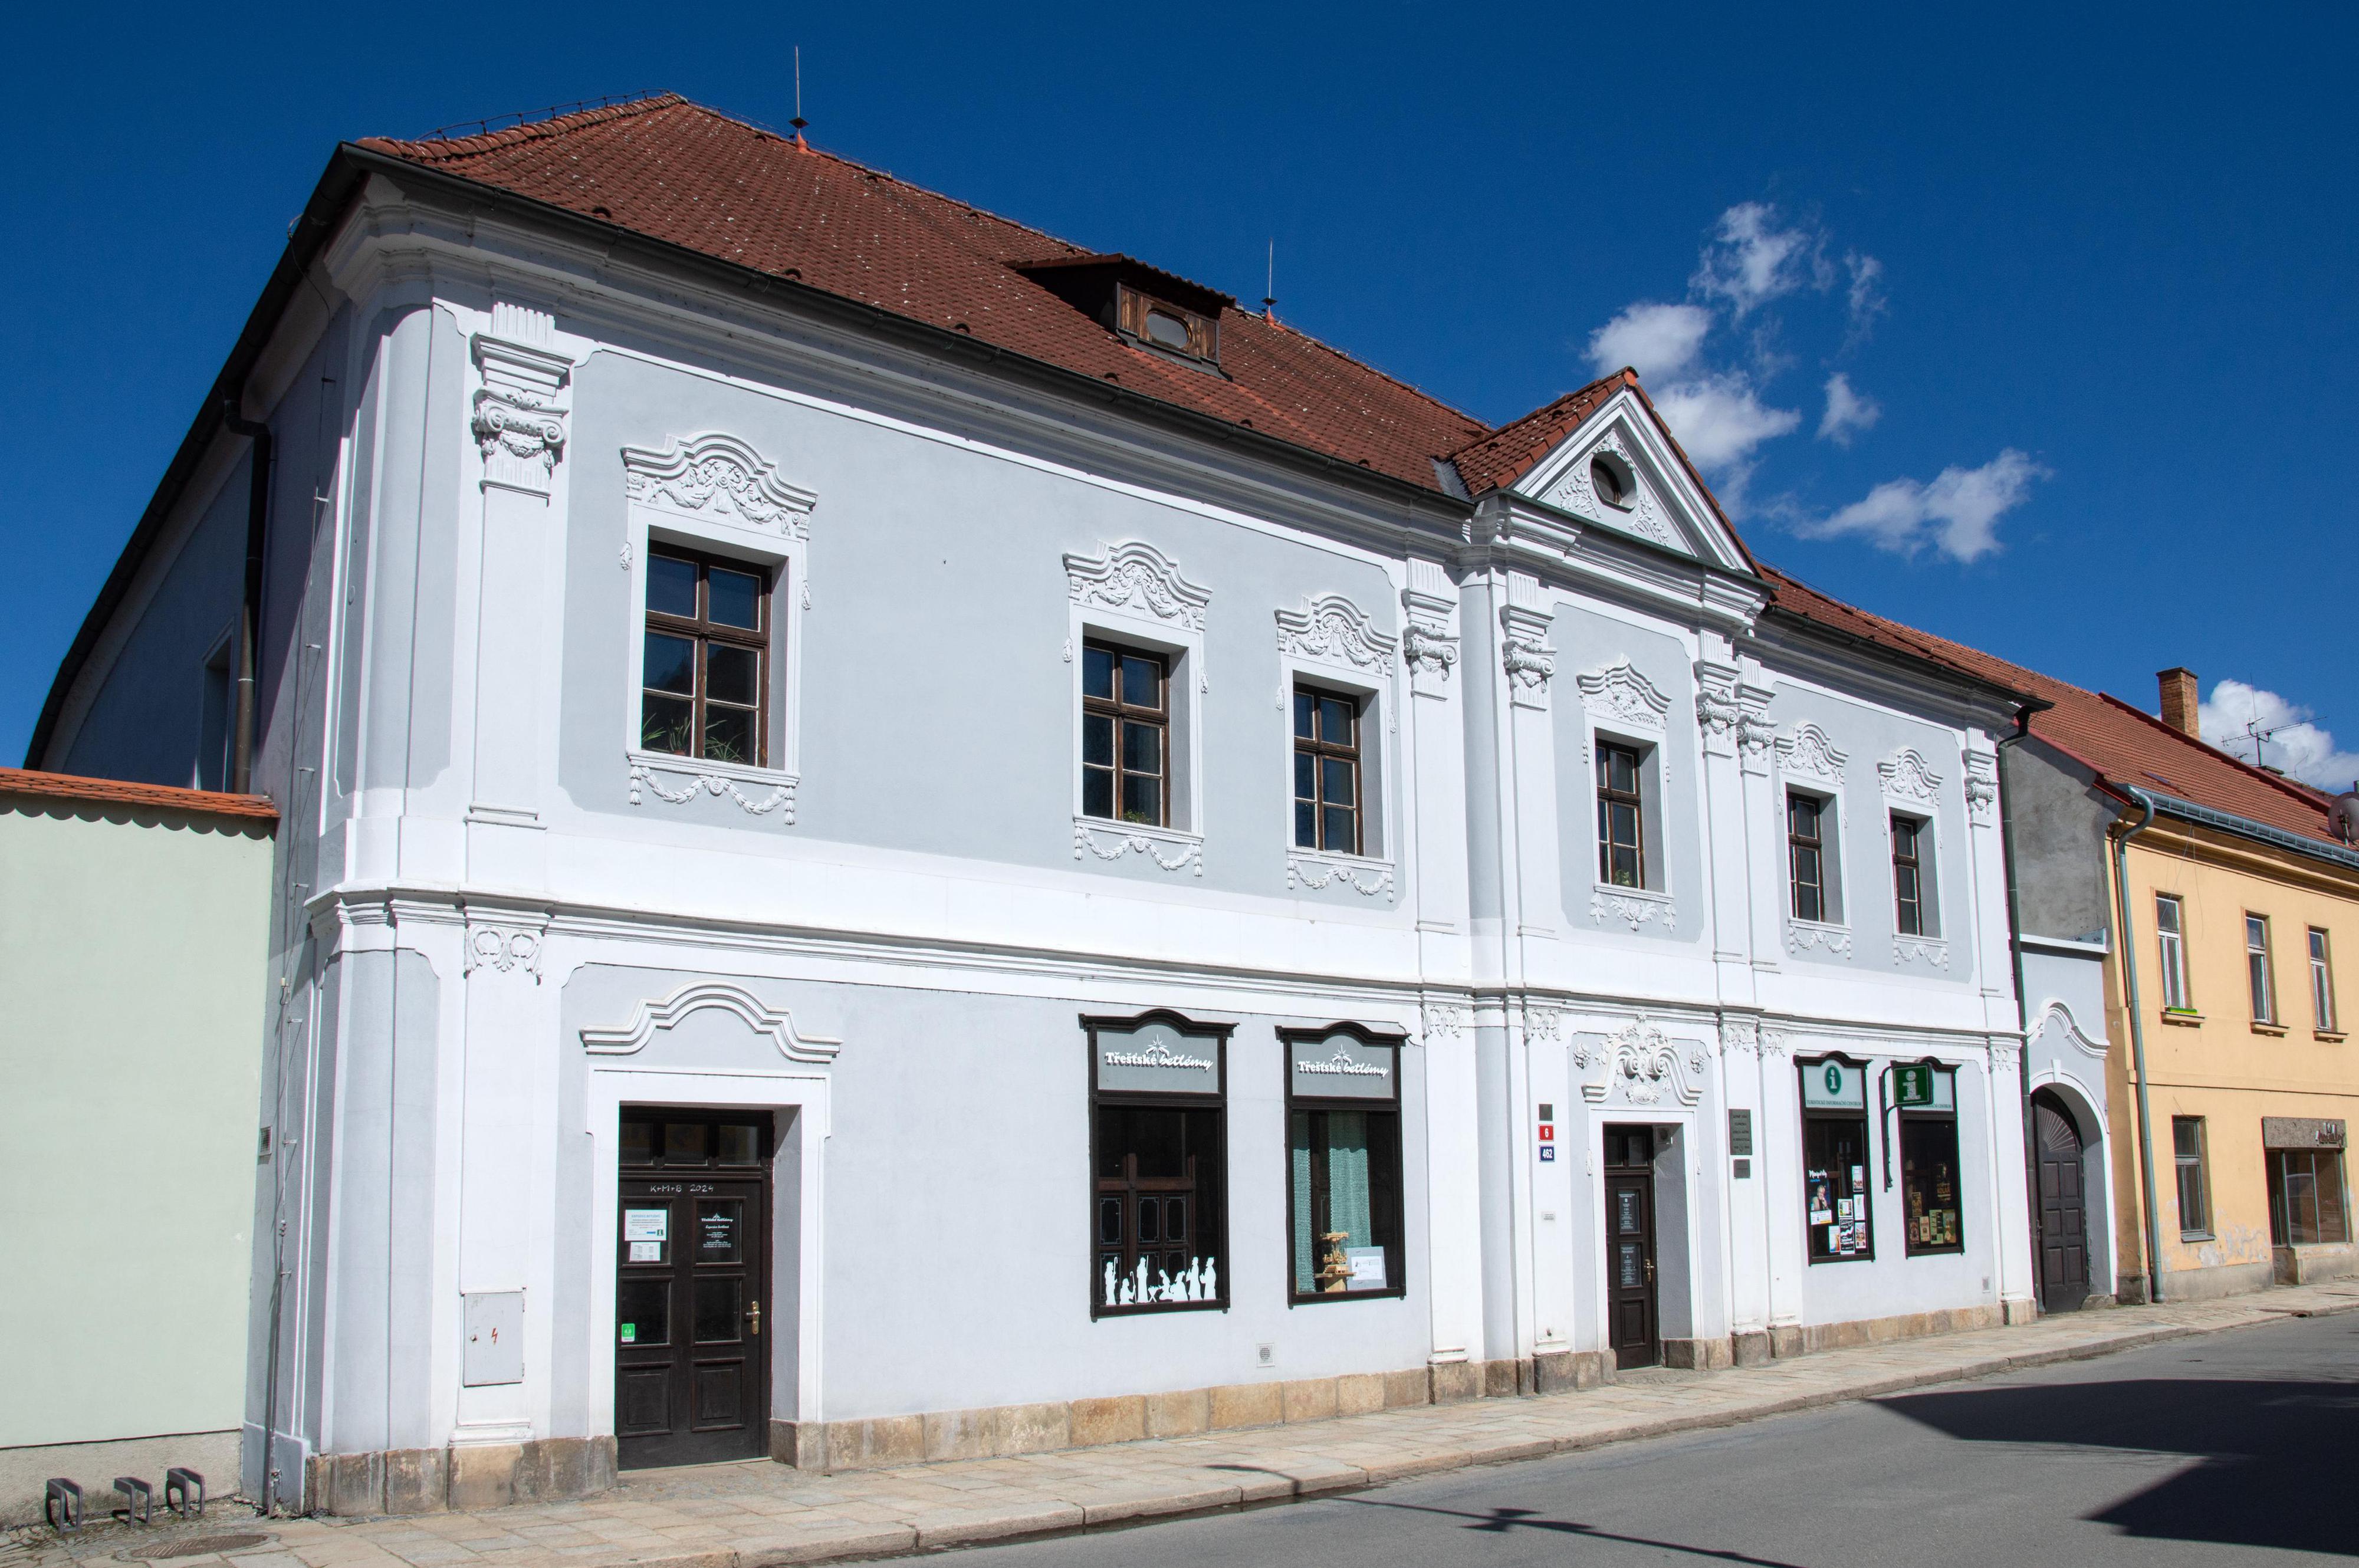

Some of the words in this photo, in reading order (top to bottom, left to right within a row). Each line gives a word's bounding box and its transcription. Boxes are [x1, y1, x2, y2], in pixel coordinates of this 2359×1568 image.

[1106, 1052, 1156, 1065] Třešťské
[1159, 1054, 1213, 1071] betlémy
[1298, 1061, 1342, 1073] Třešťské
[1343, 1063, 1389, 1077] betlémy
[1545, 1127, 1549, 1138] 6
[1542, 1148, 1553, 1159] 462
[650, 1184, 682, 1192] K+M+B
[689, 1184, 714, 1192] 2024
